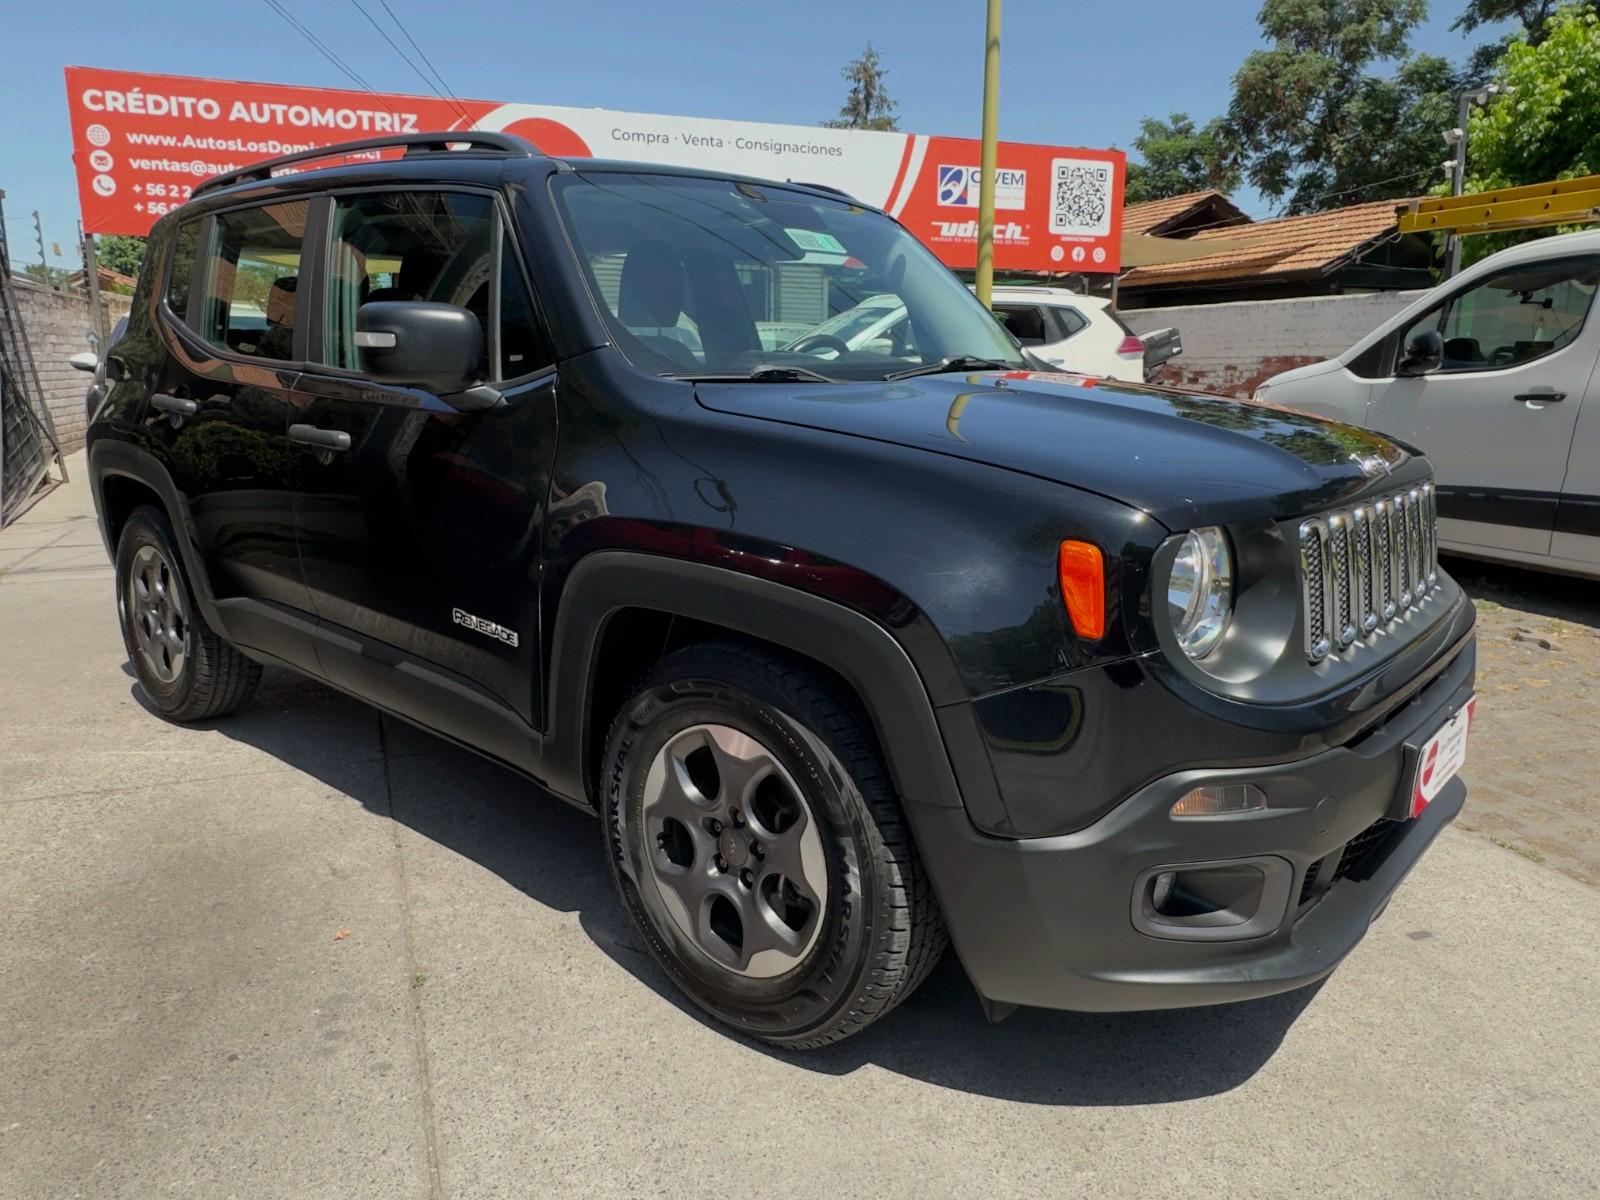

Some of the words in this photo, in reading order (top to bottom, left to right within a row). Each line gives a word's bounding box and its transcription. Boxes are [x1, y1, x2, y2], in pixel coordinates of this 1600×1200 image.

[82, 88, 221, 120] CRÉDITO
[229, 101, 419, 134] AUTOMOTRIZ
[611, 128, 670, 144] Compra
[682, 133, 724, 148] Venta
[735, 138, 843, 156] Consignaciones
[971, 170, 1024, 186] CVEM
[146, 183, 166, 197] 56
[147, 201, 168, 215] 56
[931, 220, 1029, 240] udch
[453, 607, 519, 648] RENEGADE
